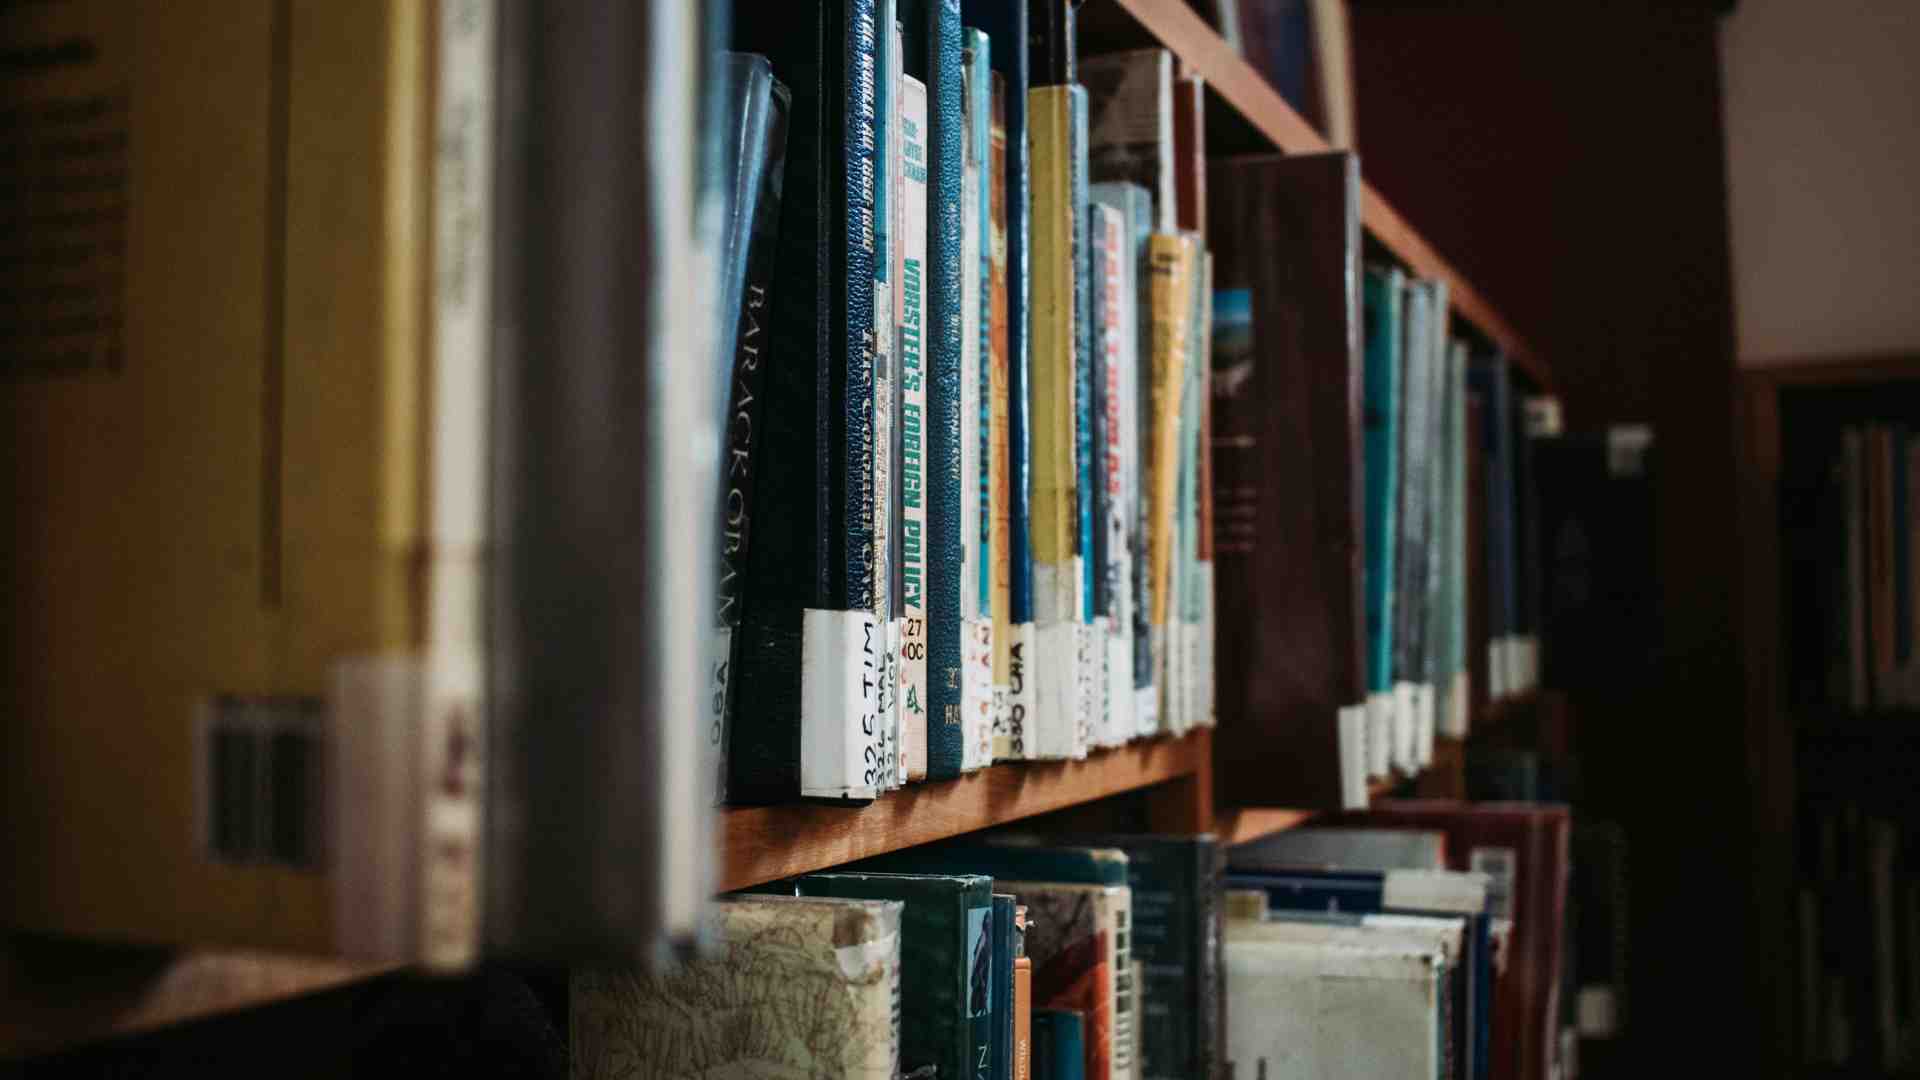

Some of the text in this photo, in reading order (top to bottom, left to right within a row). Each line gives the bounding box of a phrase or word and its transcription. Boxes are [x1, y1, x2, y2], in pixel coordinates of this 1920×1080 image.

[719, 285, 765, 629] BARACK OBAM
[862, 397, 874, 530] Colonial
[903, 404, 921, 509] FOREIGN
[903, 519, 921, 610] POLICY
[862, 622, 874, 698] TIM
[877, 654, 887, 713] MAL
